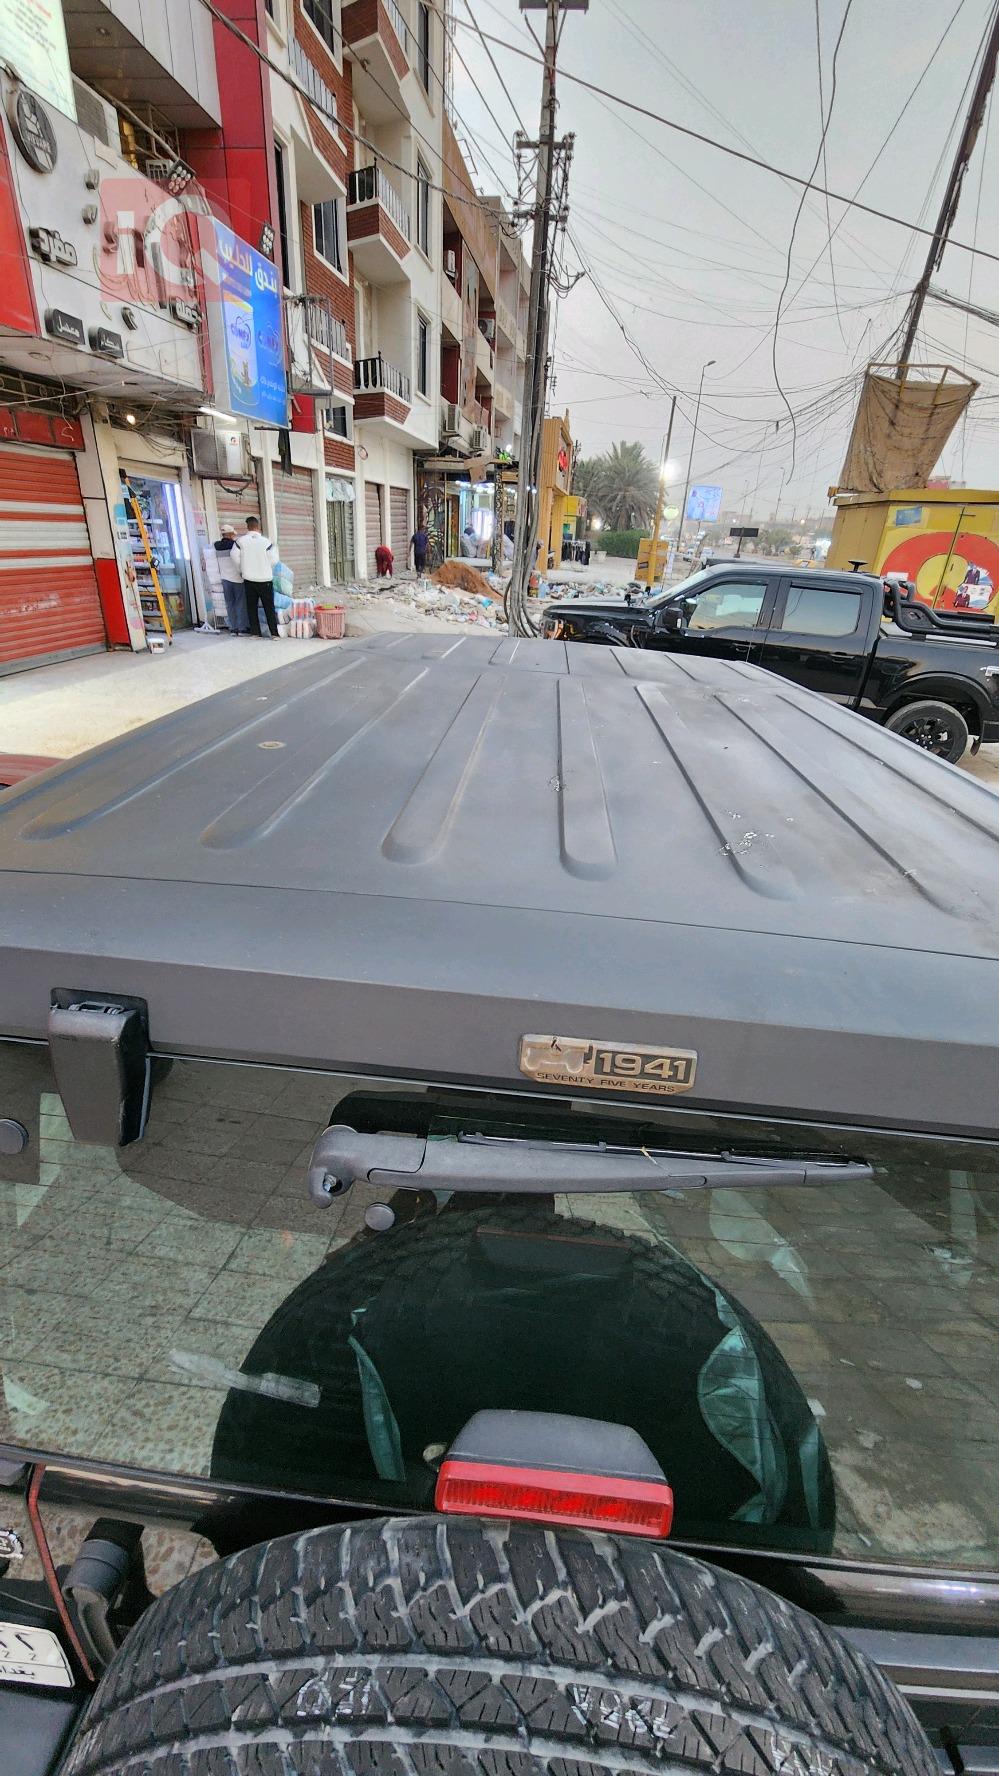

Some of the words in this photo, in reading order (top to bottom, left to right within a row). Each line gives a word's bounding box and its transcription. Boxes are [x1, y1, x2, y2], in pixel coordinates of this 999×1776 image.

[38, 227, 78, 267] مفرد
[599, 1052, 686, 1082] 1941
[536, 1072, 594, 1085] SEVENTY
[600, 1079, 627, 1088] FIVE
[633, 1082, 675, 1093] YEARS
